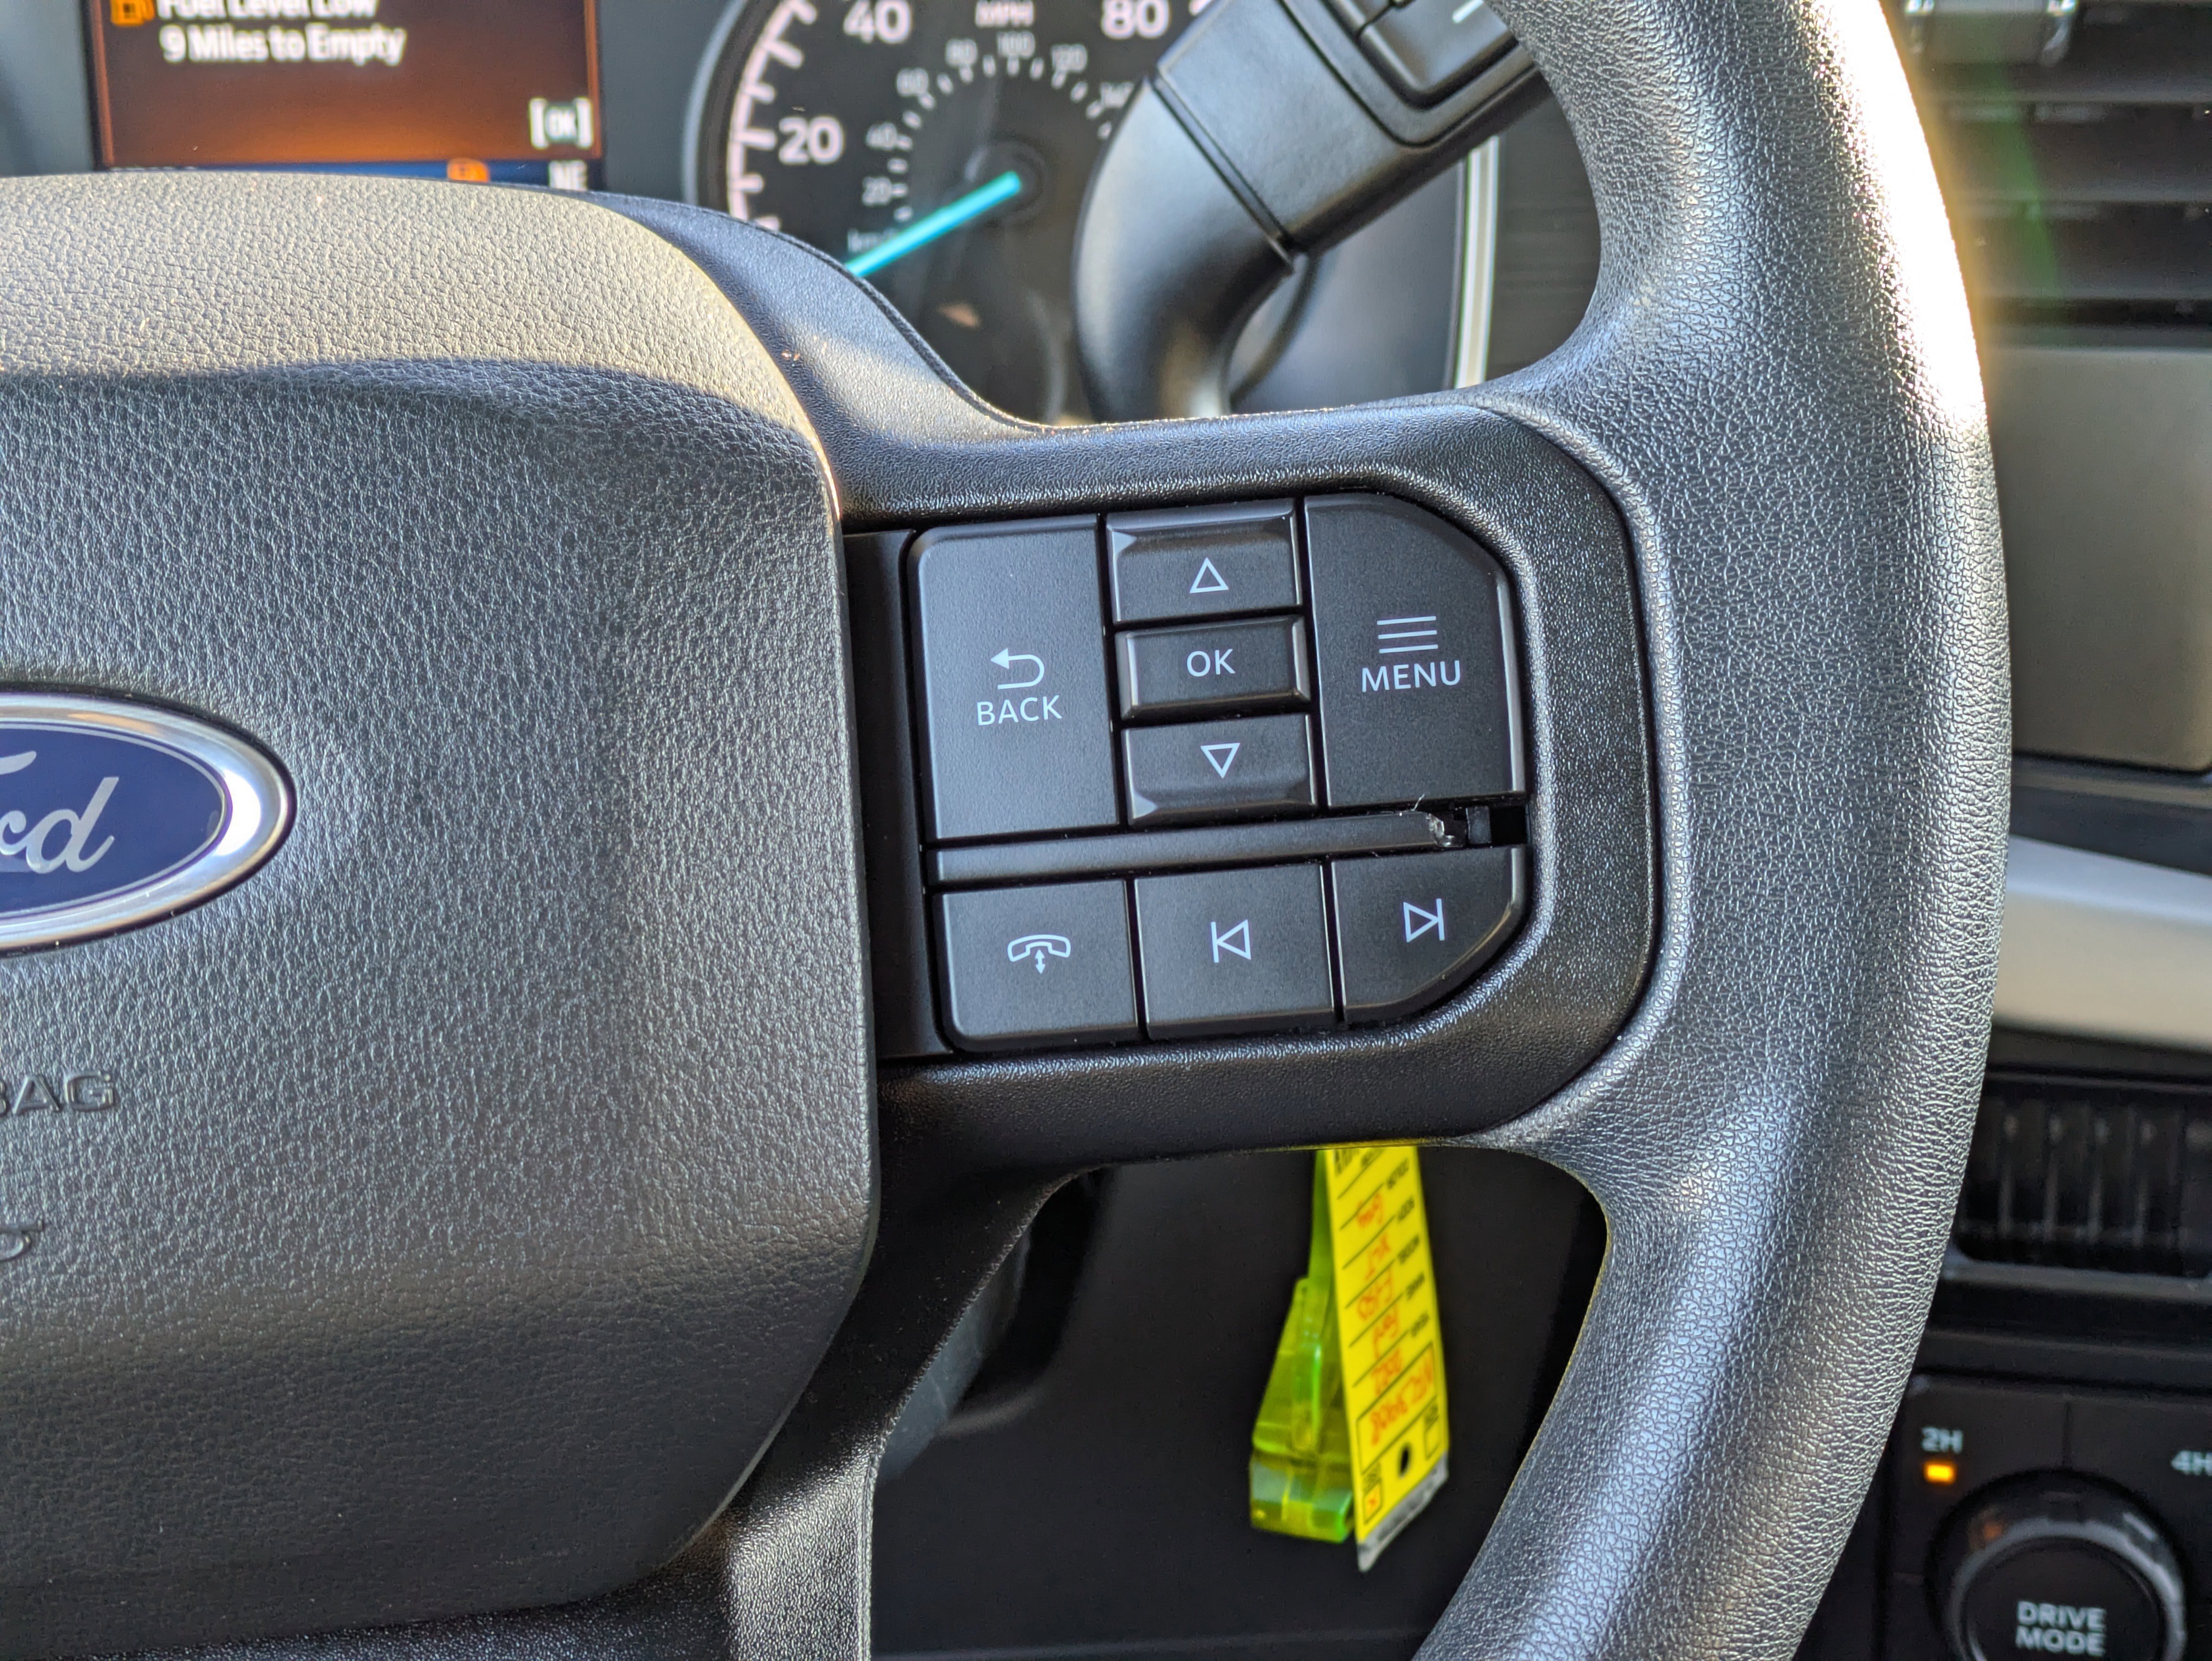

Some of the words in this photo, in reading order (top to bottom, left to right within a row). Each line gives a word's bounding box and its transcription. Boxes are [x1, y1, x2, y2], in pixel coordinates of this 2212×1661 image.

[843, 0, 911, 43] 40
[975, 0, 1035, 27] MPH
[1101, 0, 1169, 39] 80
[159, 24, 187, 63] 9
[188, 24, 268, 61] Miles
[268, 25, 306, 61] to
[306, 22, 407, 66] Empty
[997, 31, 1035, 58] 100
[1051, 44, 1087, 72] 120
[896, 68, 929, 97] 60
[778, 116, 844, 165] 20
[866, 123, 897, 150] 40
[863, 176, 892, 206] 20
[1186, 648, 1235, 677] OK
[1361, 660, 1461, 692] MENU
[976, 695, 1062, 726] BACK
[0, 1070, 116, 1118] AG
[1922, 1427, 1964, 1453] 2H
[2017, 1600, 2106, 1630] DRIVE
[2015, 1628, 2105, 1657] MODE
